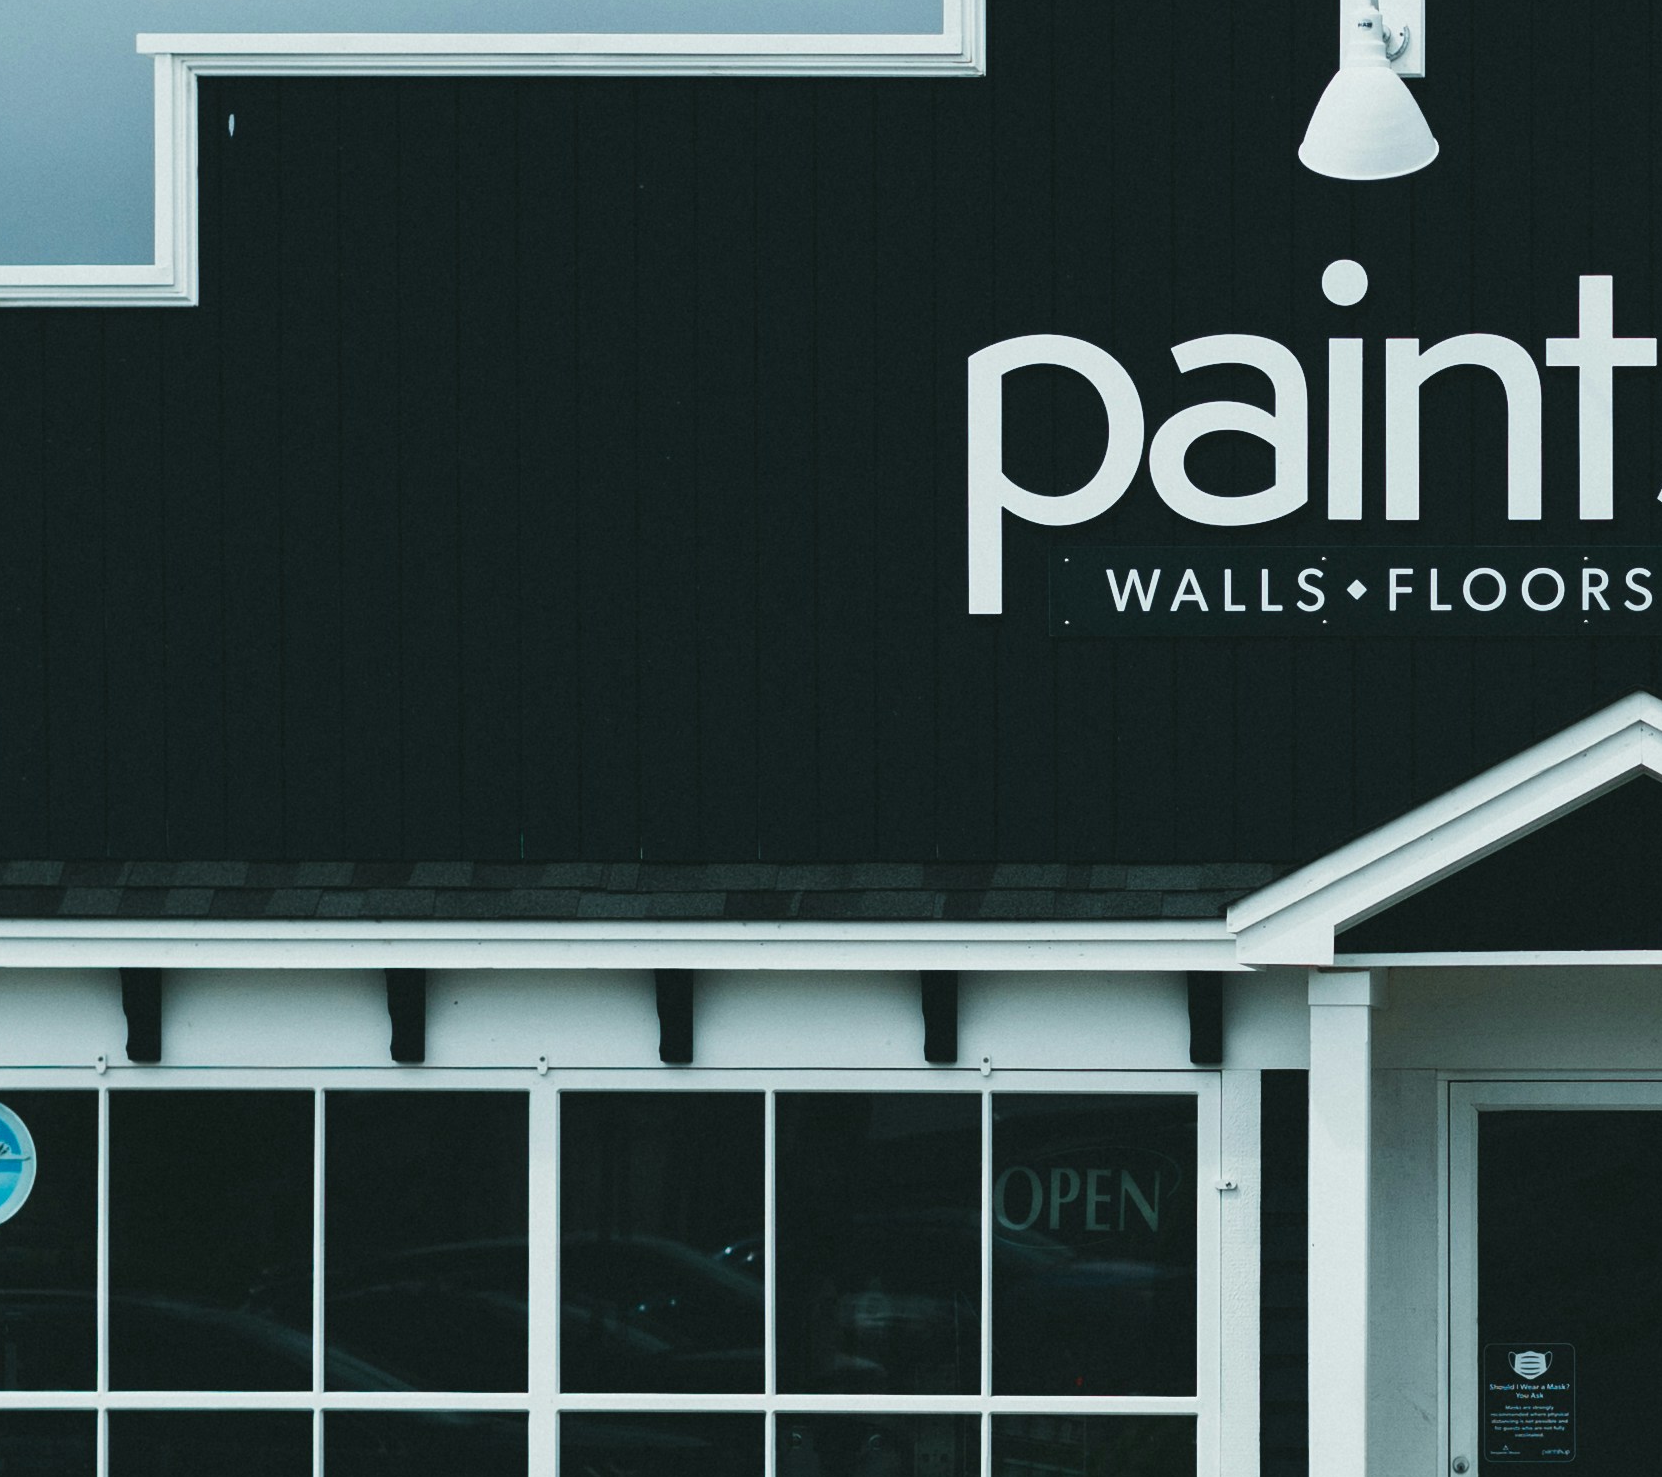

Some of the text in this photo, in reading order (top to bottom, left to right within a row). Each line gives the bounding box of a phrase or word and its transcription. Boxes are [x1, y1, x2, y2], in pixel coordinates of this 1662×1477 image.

[1105, 568, 1325, 612] WALLS
[1389, 568, 1653, 612] FLOORS
[993, 1165, 1161, 1233] OPEN
